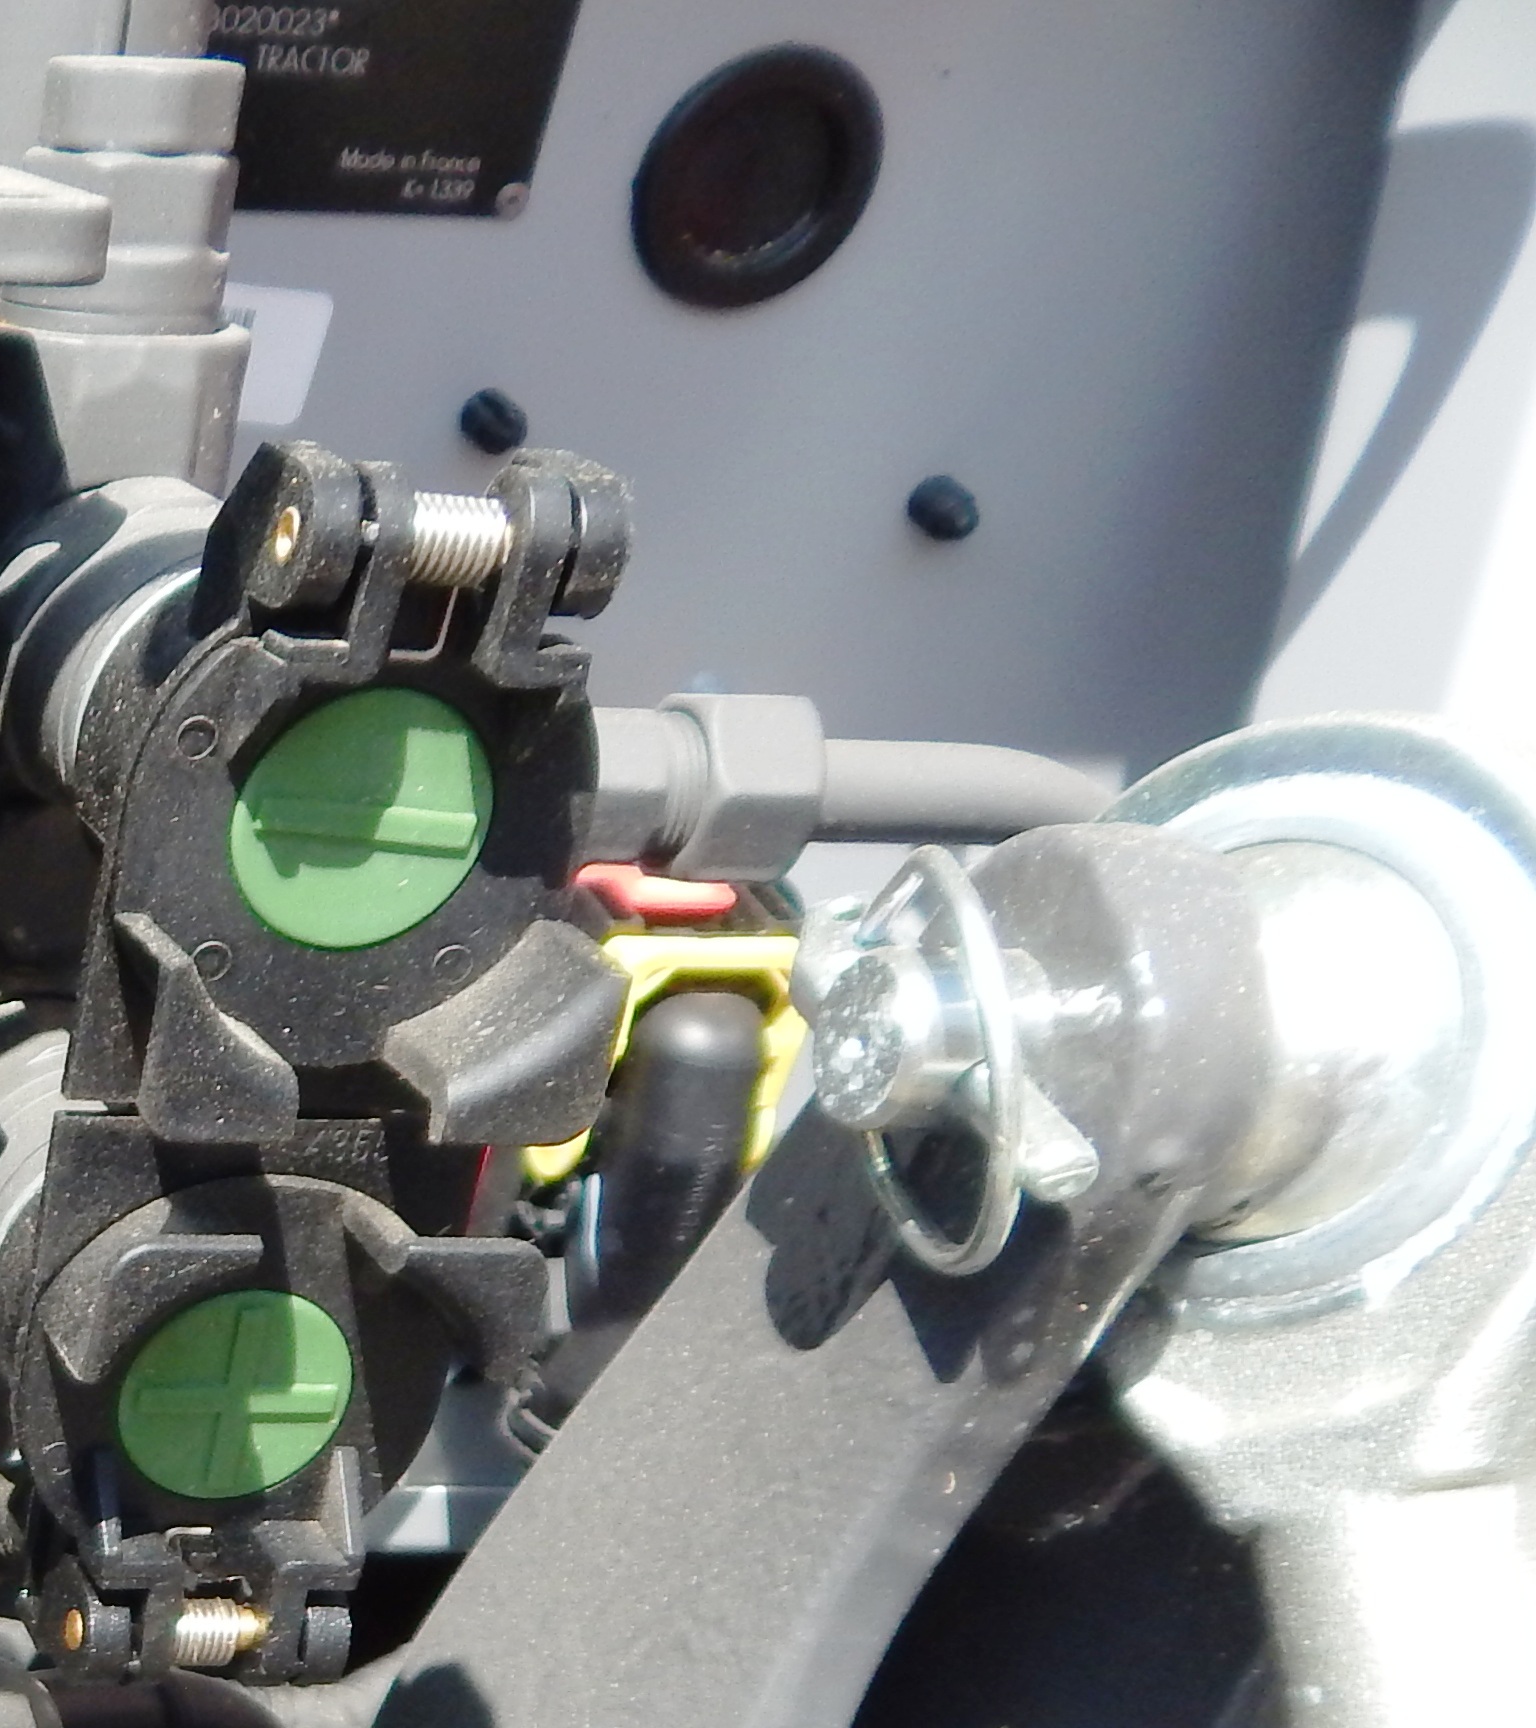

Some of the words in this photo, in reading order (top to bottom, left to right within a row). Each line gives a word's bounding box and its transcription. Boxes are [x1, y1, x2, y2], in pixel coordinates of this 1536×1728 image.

[257, 43, 371, 75] TRACTOR
[340, 147, 396, 170] Made
[400, 151, 417, 169] in
[422, 149, 482, 172] France
